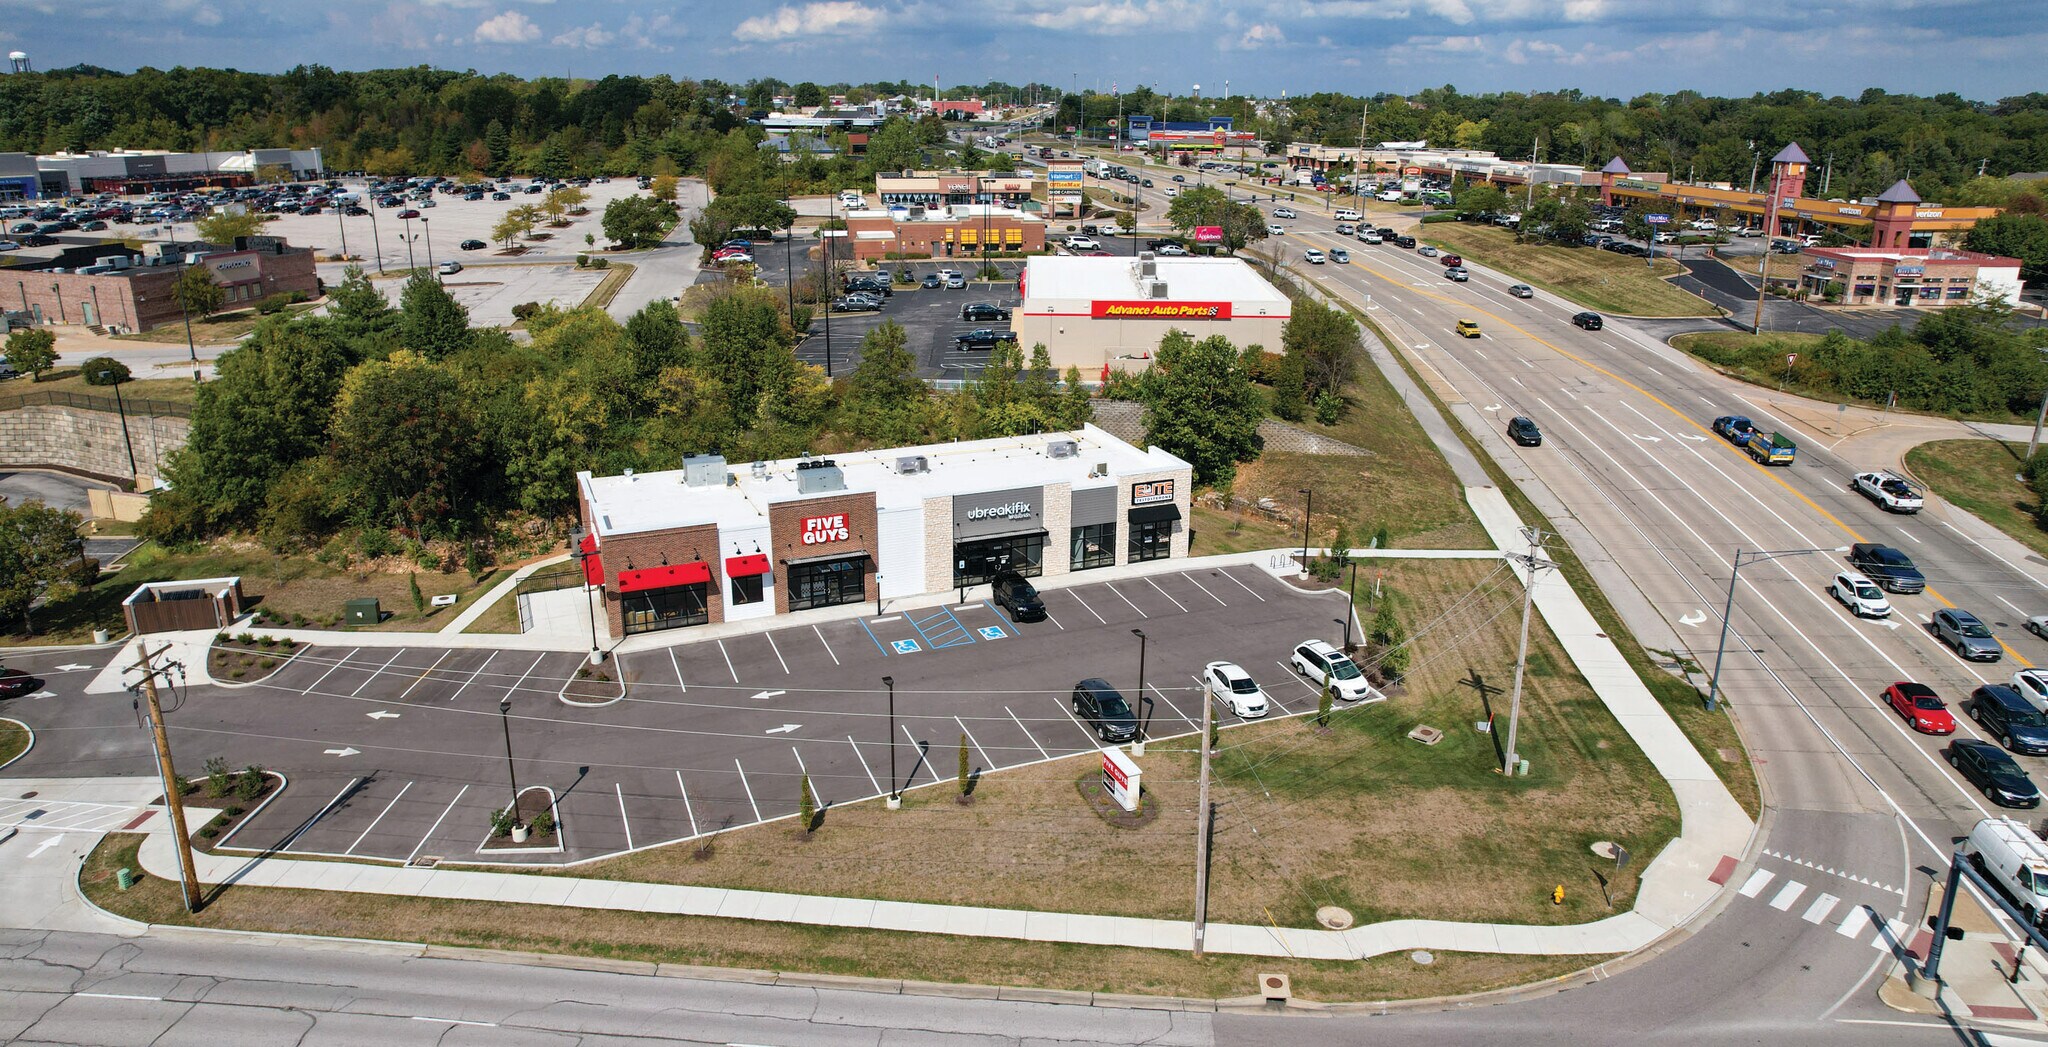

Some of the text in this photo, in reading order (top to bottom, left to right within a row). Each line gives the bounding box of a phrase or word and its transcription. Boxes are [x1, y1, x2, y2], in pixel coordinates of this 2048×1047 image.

[1916, 209, 1942, 217] verizon
[1106, 305, 1208, 316] Advance Auto Parts
[1135, 481, 1173, 497] ELITE
[967, 502, 1030, 519] ubreakifix
[806, 515, 844, 532] FIVE
[803, 527, 849, 544] GUYS
[1103, 757, 1115, 772] FIVE
[1114, 768, 1128, 786] GUYS
